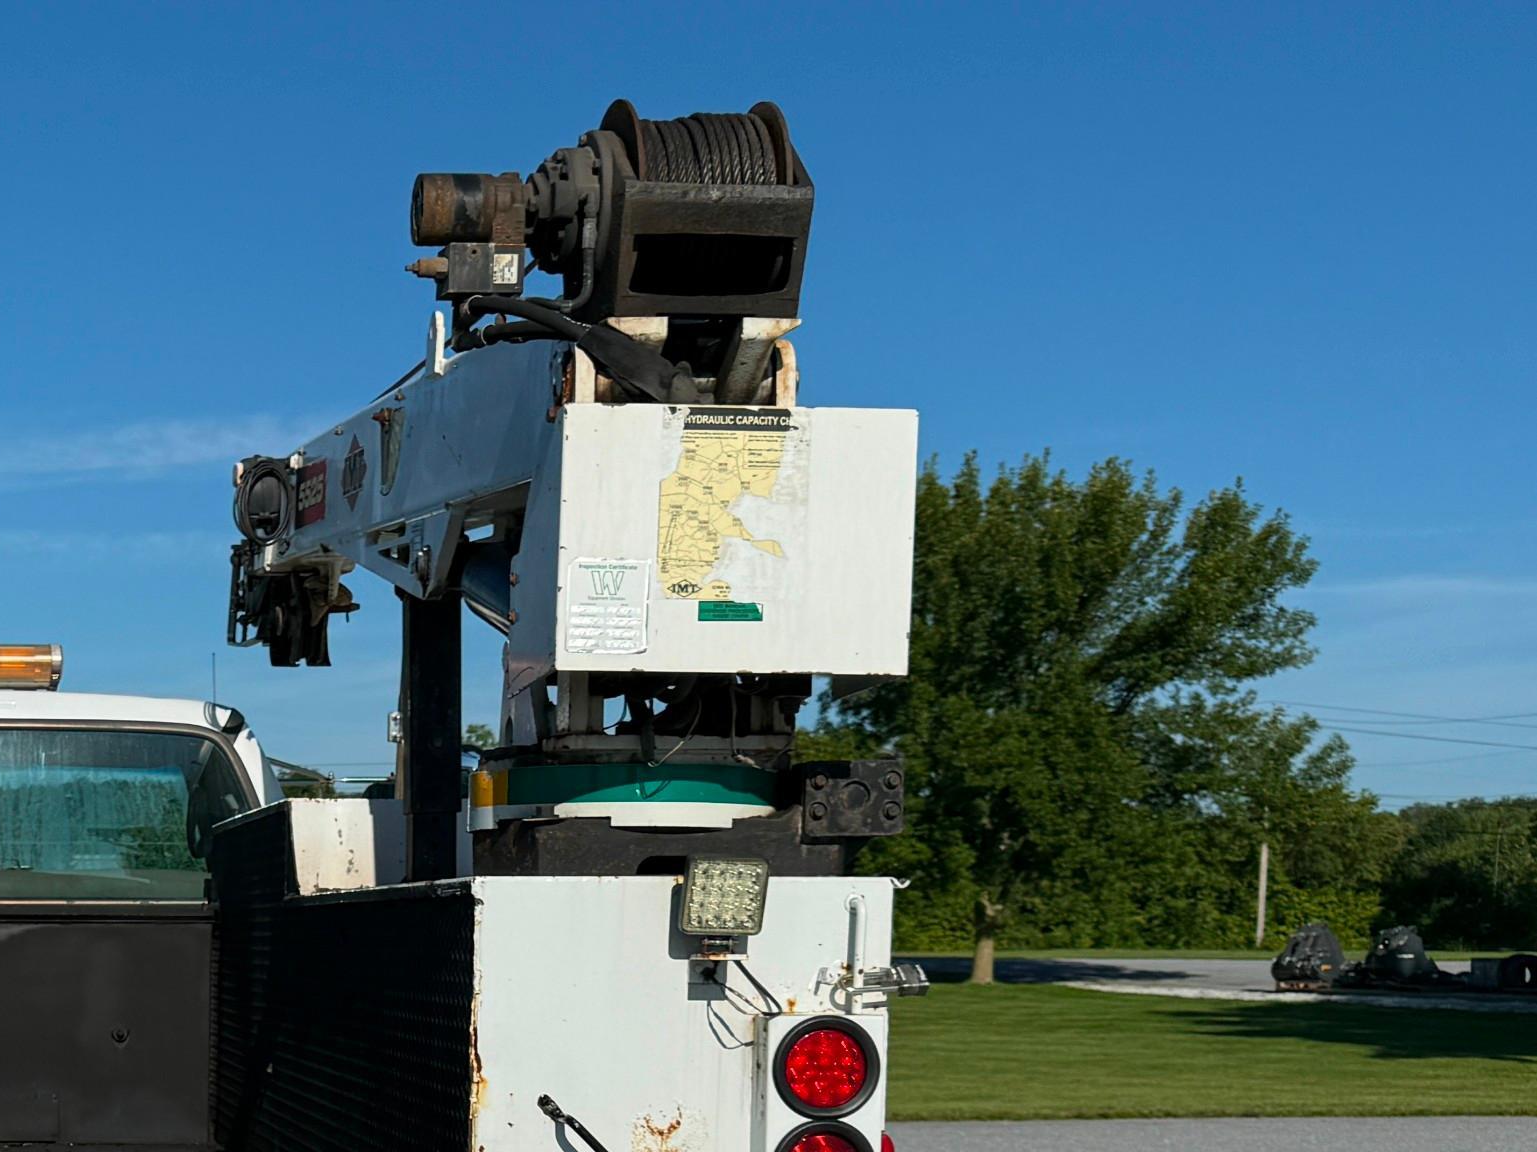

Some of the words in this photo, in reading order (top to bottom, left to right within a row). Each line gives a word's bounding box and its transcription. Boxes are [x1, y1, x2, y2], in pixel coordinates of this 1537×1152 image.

[685, 415, 735, 425] HYDRAULIC
[735, 415, 779, 426] CAPACITY
[671, 583, 698, 594] IMT
